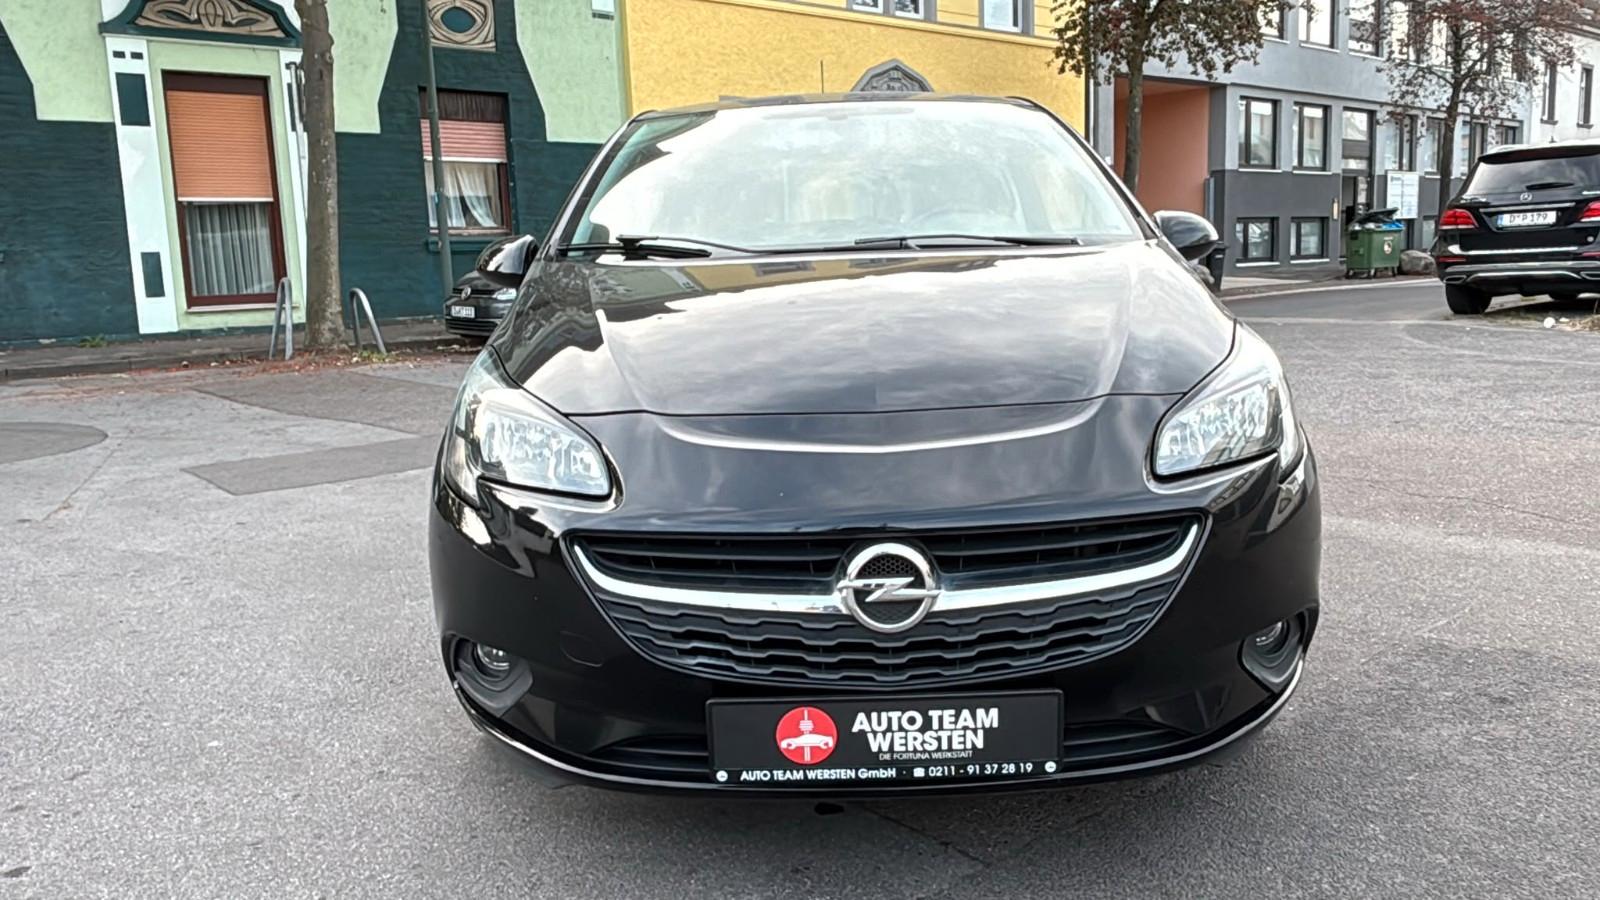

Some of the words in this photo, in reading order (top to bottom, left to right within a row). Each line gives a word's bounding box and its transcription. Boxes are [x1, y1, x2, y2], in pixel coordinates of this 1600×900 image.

[851, 710, 923, 733] AUTO
[928, 707, 999, 730] TEAM
[866, 729, 984, 752] WERSTEN
[879, 752, 891, 761] DIE
[893, 751, 930, 760] FORTUNA
[931, 750, 973, 759] WERKSTATT
[740, 770, 771, 781] AUTO
[773, 769, 804, 780] TEAM
[805, 768, 855, 780] WERSTEN
[858, 768, 896, 779] GmbH
[928, 765, 956, 777] 0211
[966, 764, 980, 775] 91
[984, 763, 998, 775] 37
[1001, 763, 1016, 774] 28
[1019, 762, 1033, 773] 19
